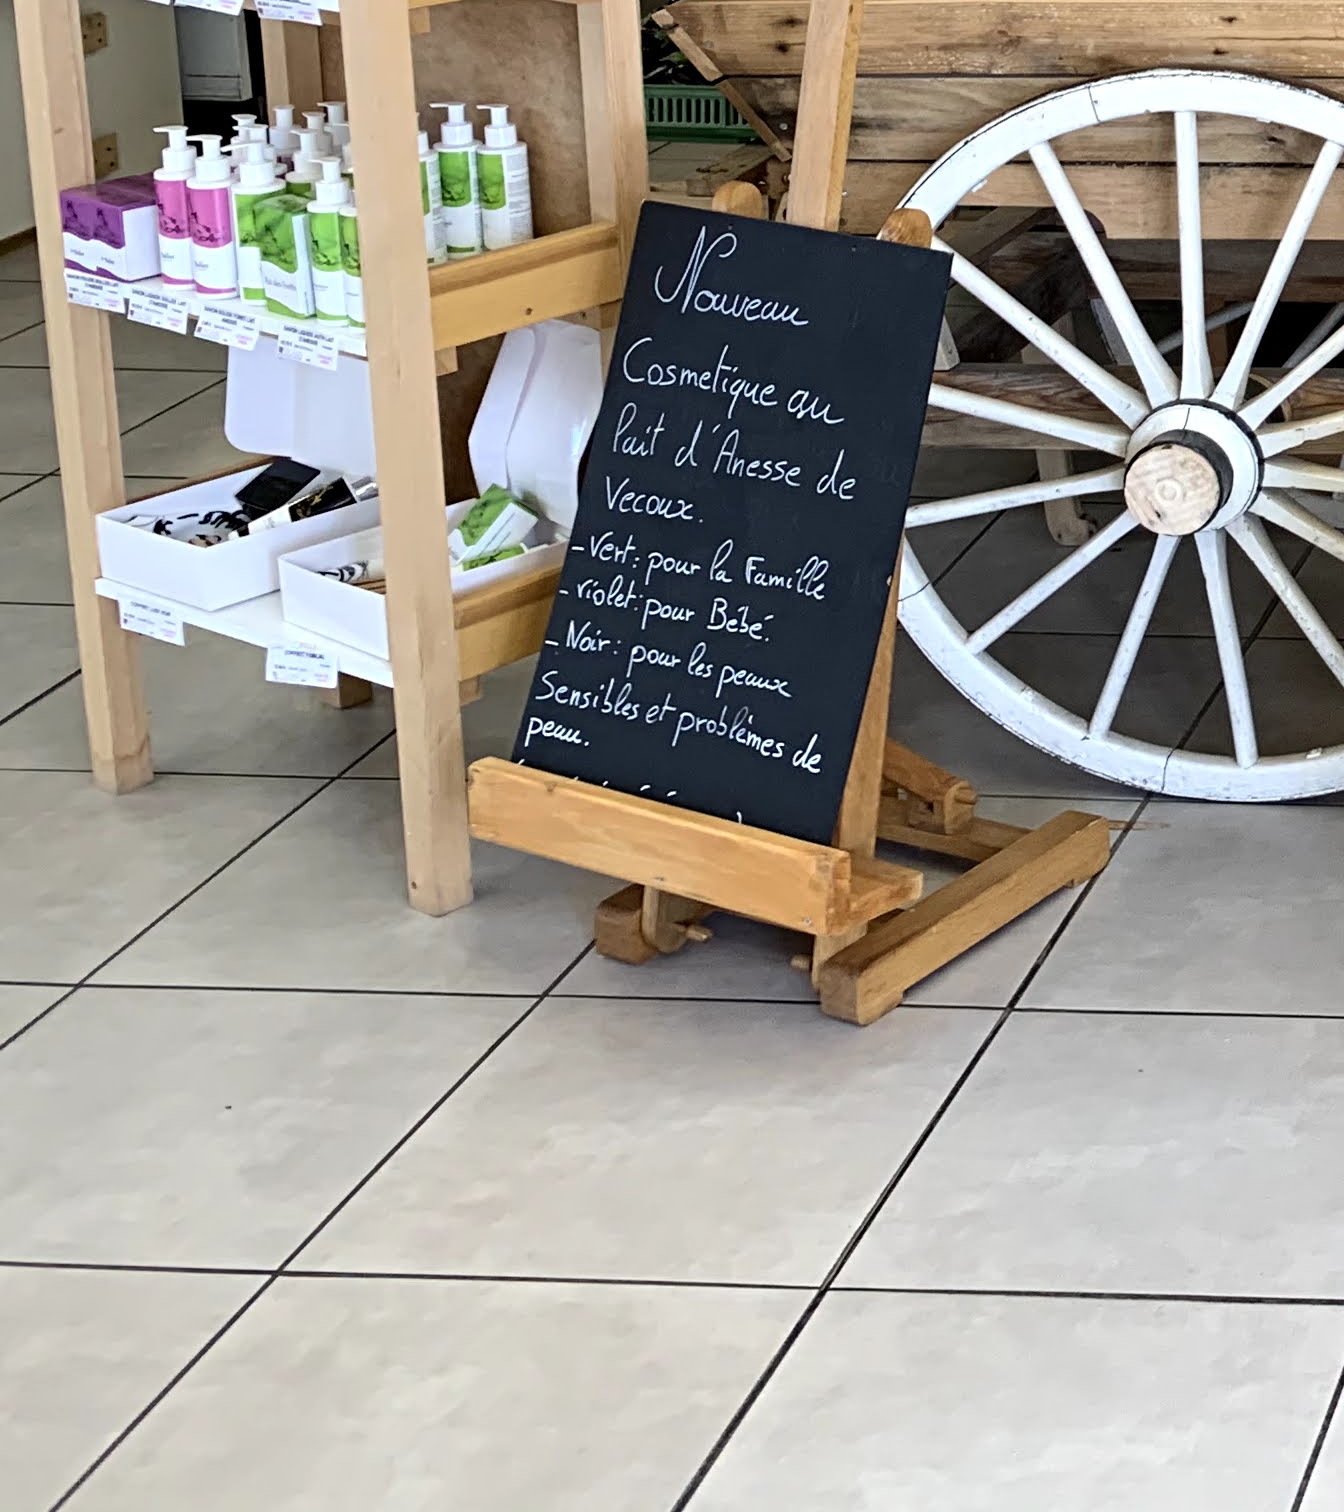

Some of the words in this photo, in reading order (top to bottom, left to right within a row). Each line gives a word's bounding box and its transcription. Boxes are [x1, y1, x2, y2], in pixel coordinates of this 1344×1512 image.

[654, 225, 808, 326] Nouveau
[623, 337, 778, 420] Cosmetique
[787, 390, 845, 425] au
[675, 419, 802, 488] d'Anesse
[817, 449, 857, 501] de
[645, 551, 701, 586] pour
[710, 538, 734, 584] la
[745, 555, 830, 601] Famille
[641, 595, 696, 631] pour
[626, 643, 681, 679] pour
[687, 642, 713, 680] les
[715, 665, 794, 699] peaux
[524, 717, 590, 748] peau.
[535, 669, 640, 721] Sensibles
[645, 692, 678, 724] et
[792, 733, 822, 775] de
